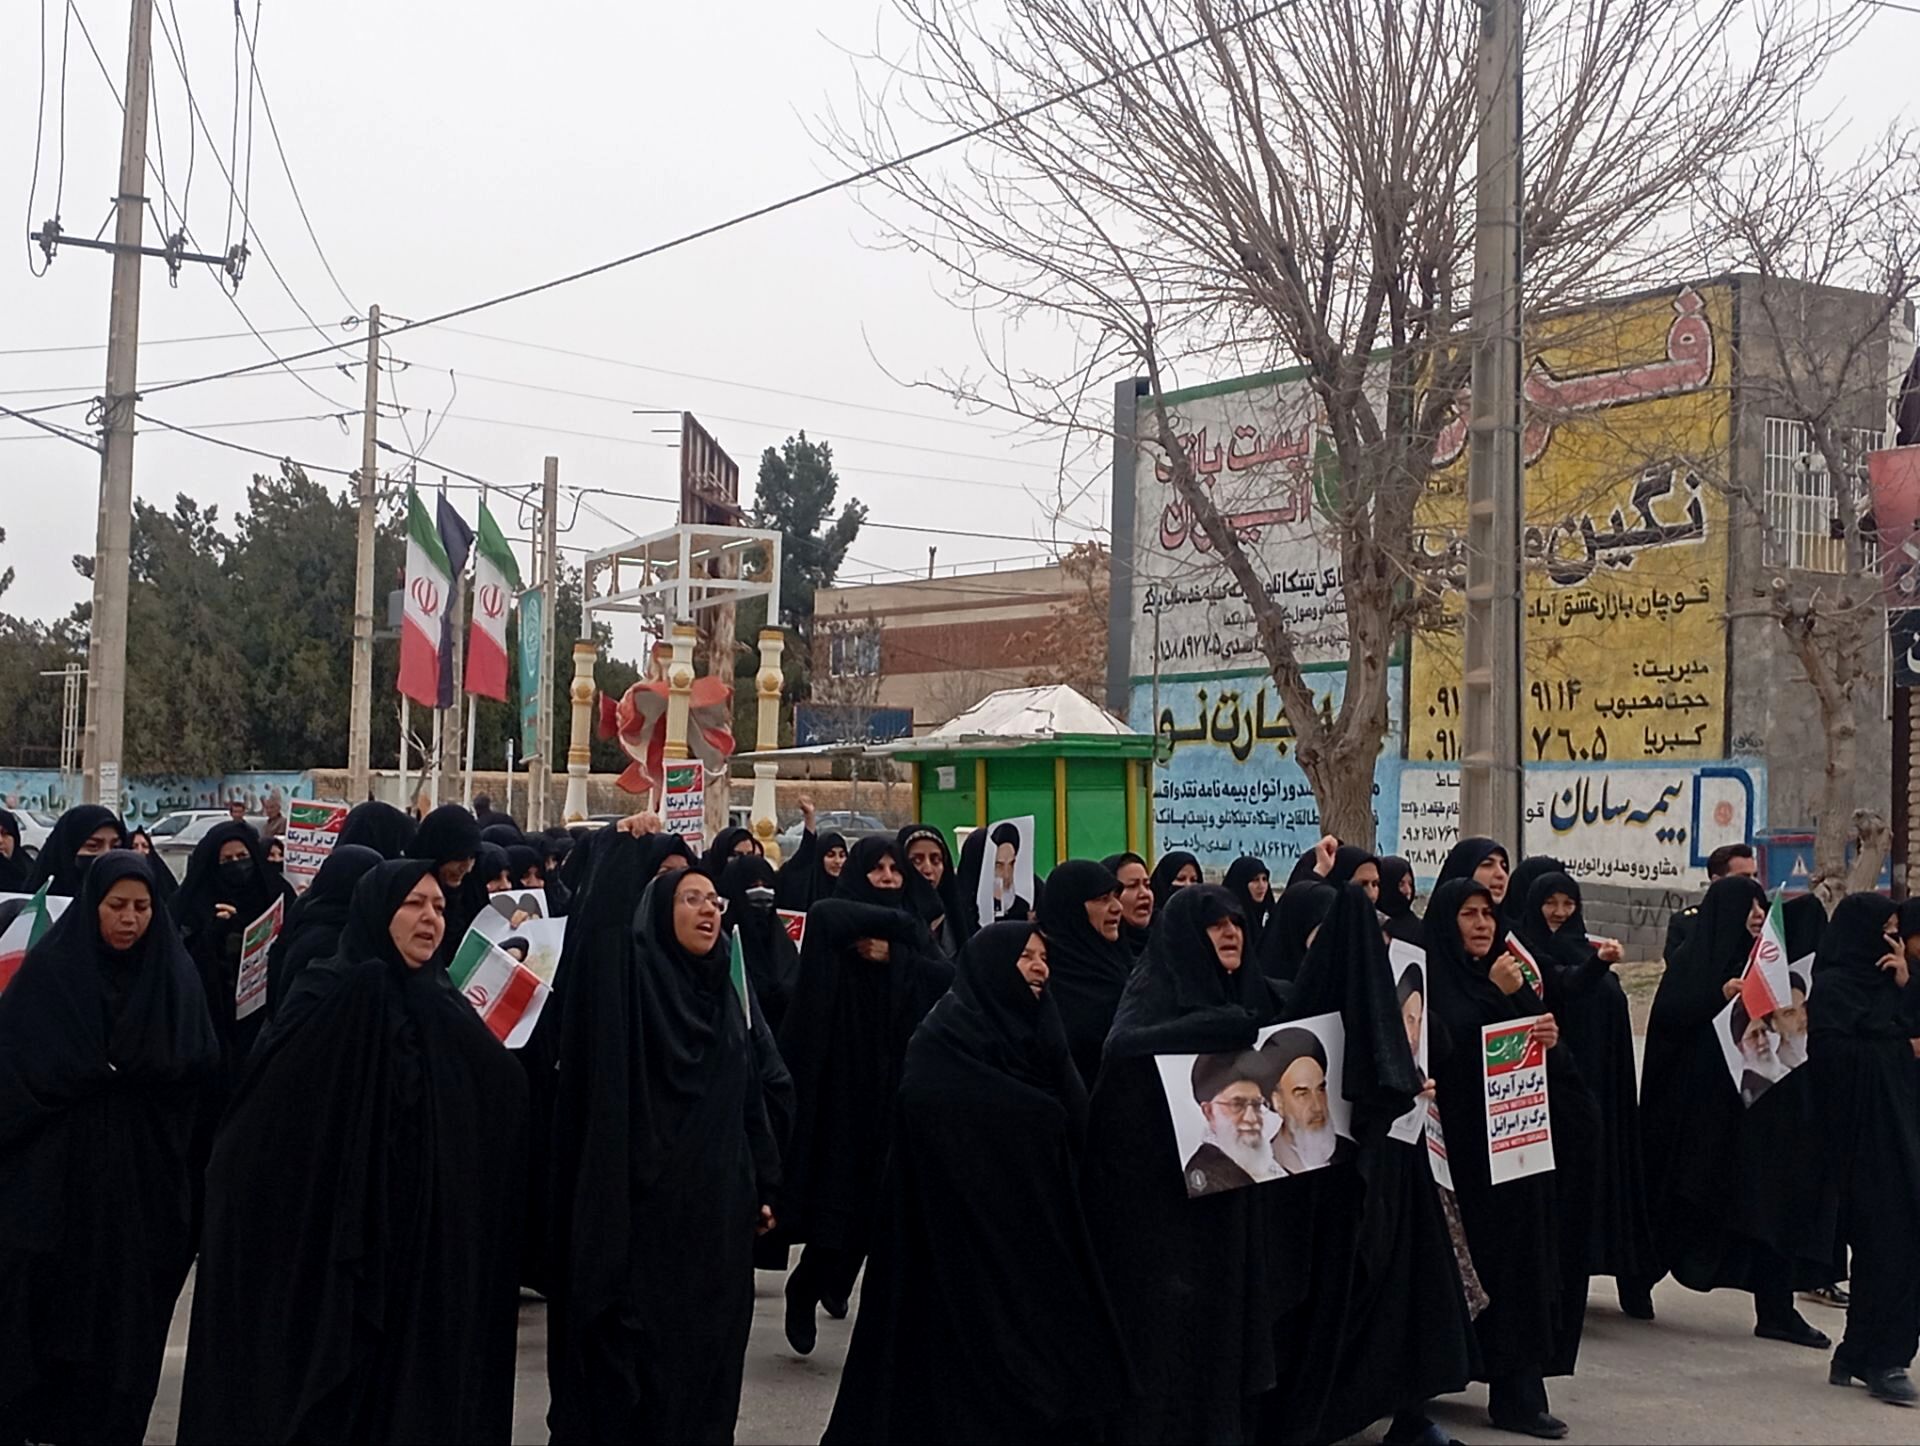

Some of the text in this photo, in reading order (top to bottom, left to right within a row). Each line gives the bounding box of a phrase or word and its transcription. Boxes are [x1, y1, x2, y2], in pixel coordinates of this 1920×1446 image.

[1315, 567, 1345, 597] انکی
[1527, 594, 1558, 625] آباد
[1594, 590, 1634, 621] بازار
[1636, 578, 1710, 621] قوچان
[1632, 659, 1710, 684] مدیریت:
[1593, 692, 1711, 719] حجت محبوب
[1642, 723, 1708, 755] کبریا
[1180, 779, 1198, 799] نقد
[1198, 779, 1221, 798] نامه
[1221, 784, 1249, 804] بیمه
[1250, 778, 1281, 804] انواع
[1550, 775, 1688, 846] بیمه سامان
[1599, 859, 1630, 877] صدور
[1630, 862, 1638, 877] و
[1638, 856, 1679, 881] مشاوره
[1487, 1073, 1517, 1100] آمریکا
[1491, 1113, 1520, 1138] اسرائیل
